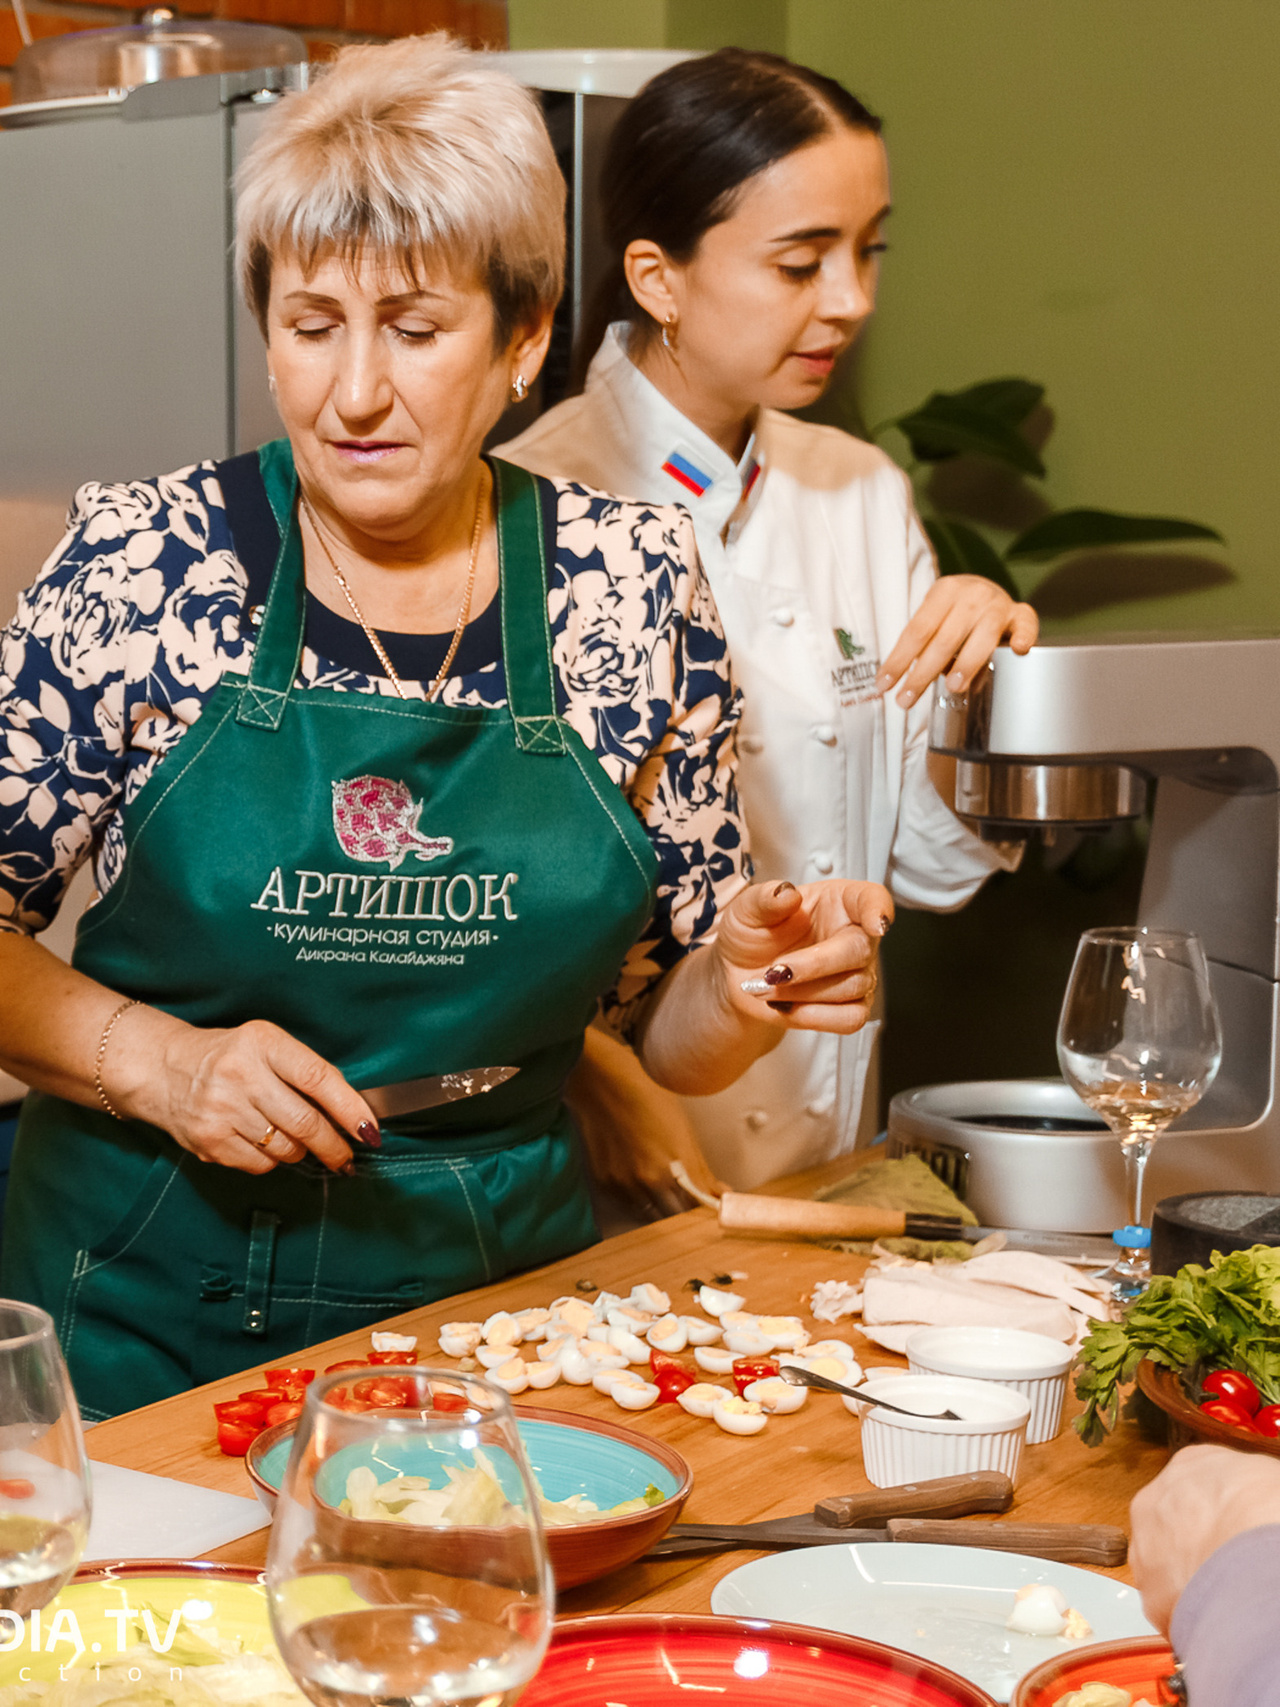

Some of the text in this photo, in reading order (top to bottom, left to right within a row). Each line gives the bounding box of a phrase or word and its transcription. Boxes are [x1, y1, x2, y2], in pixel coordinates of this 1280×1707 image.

[250, 866, 520, 923] АРТИШОК
[274, 922, 491, 950] кулинарная студия
[295, 947, 367, 963] Дикрана
